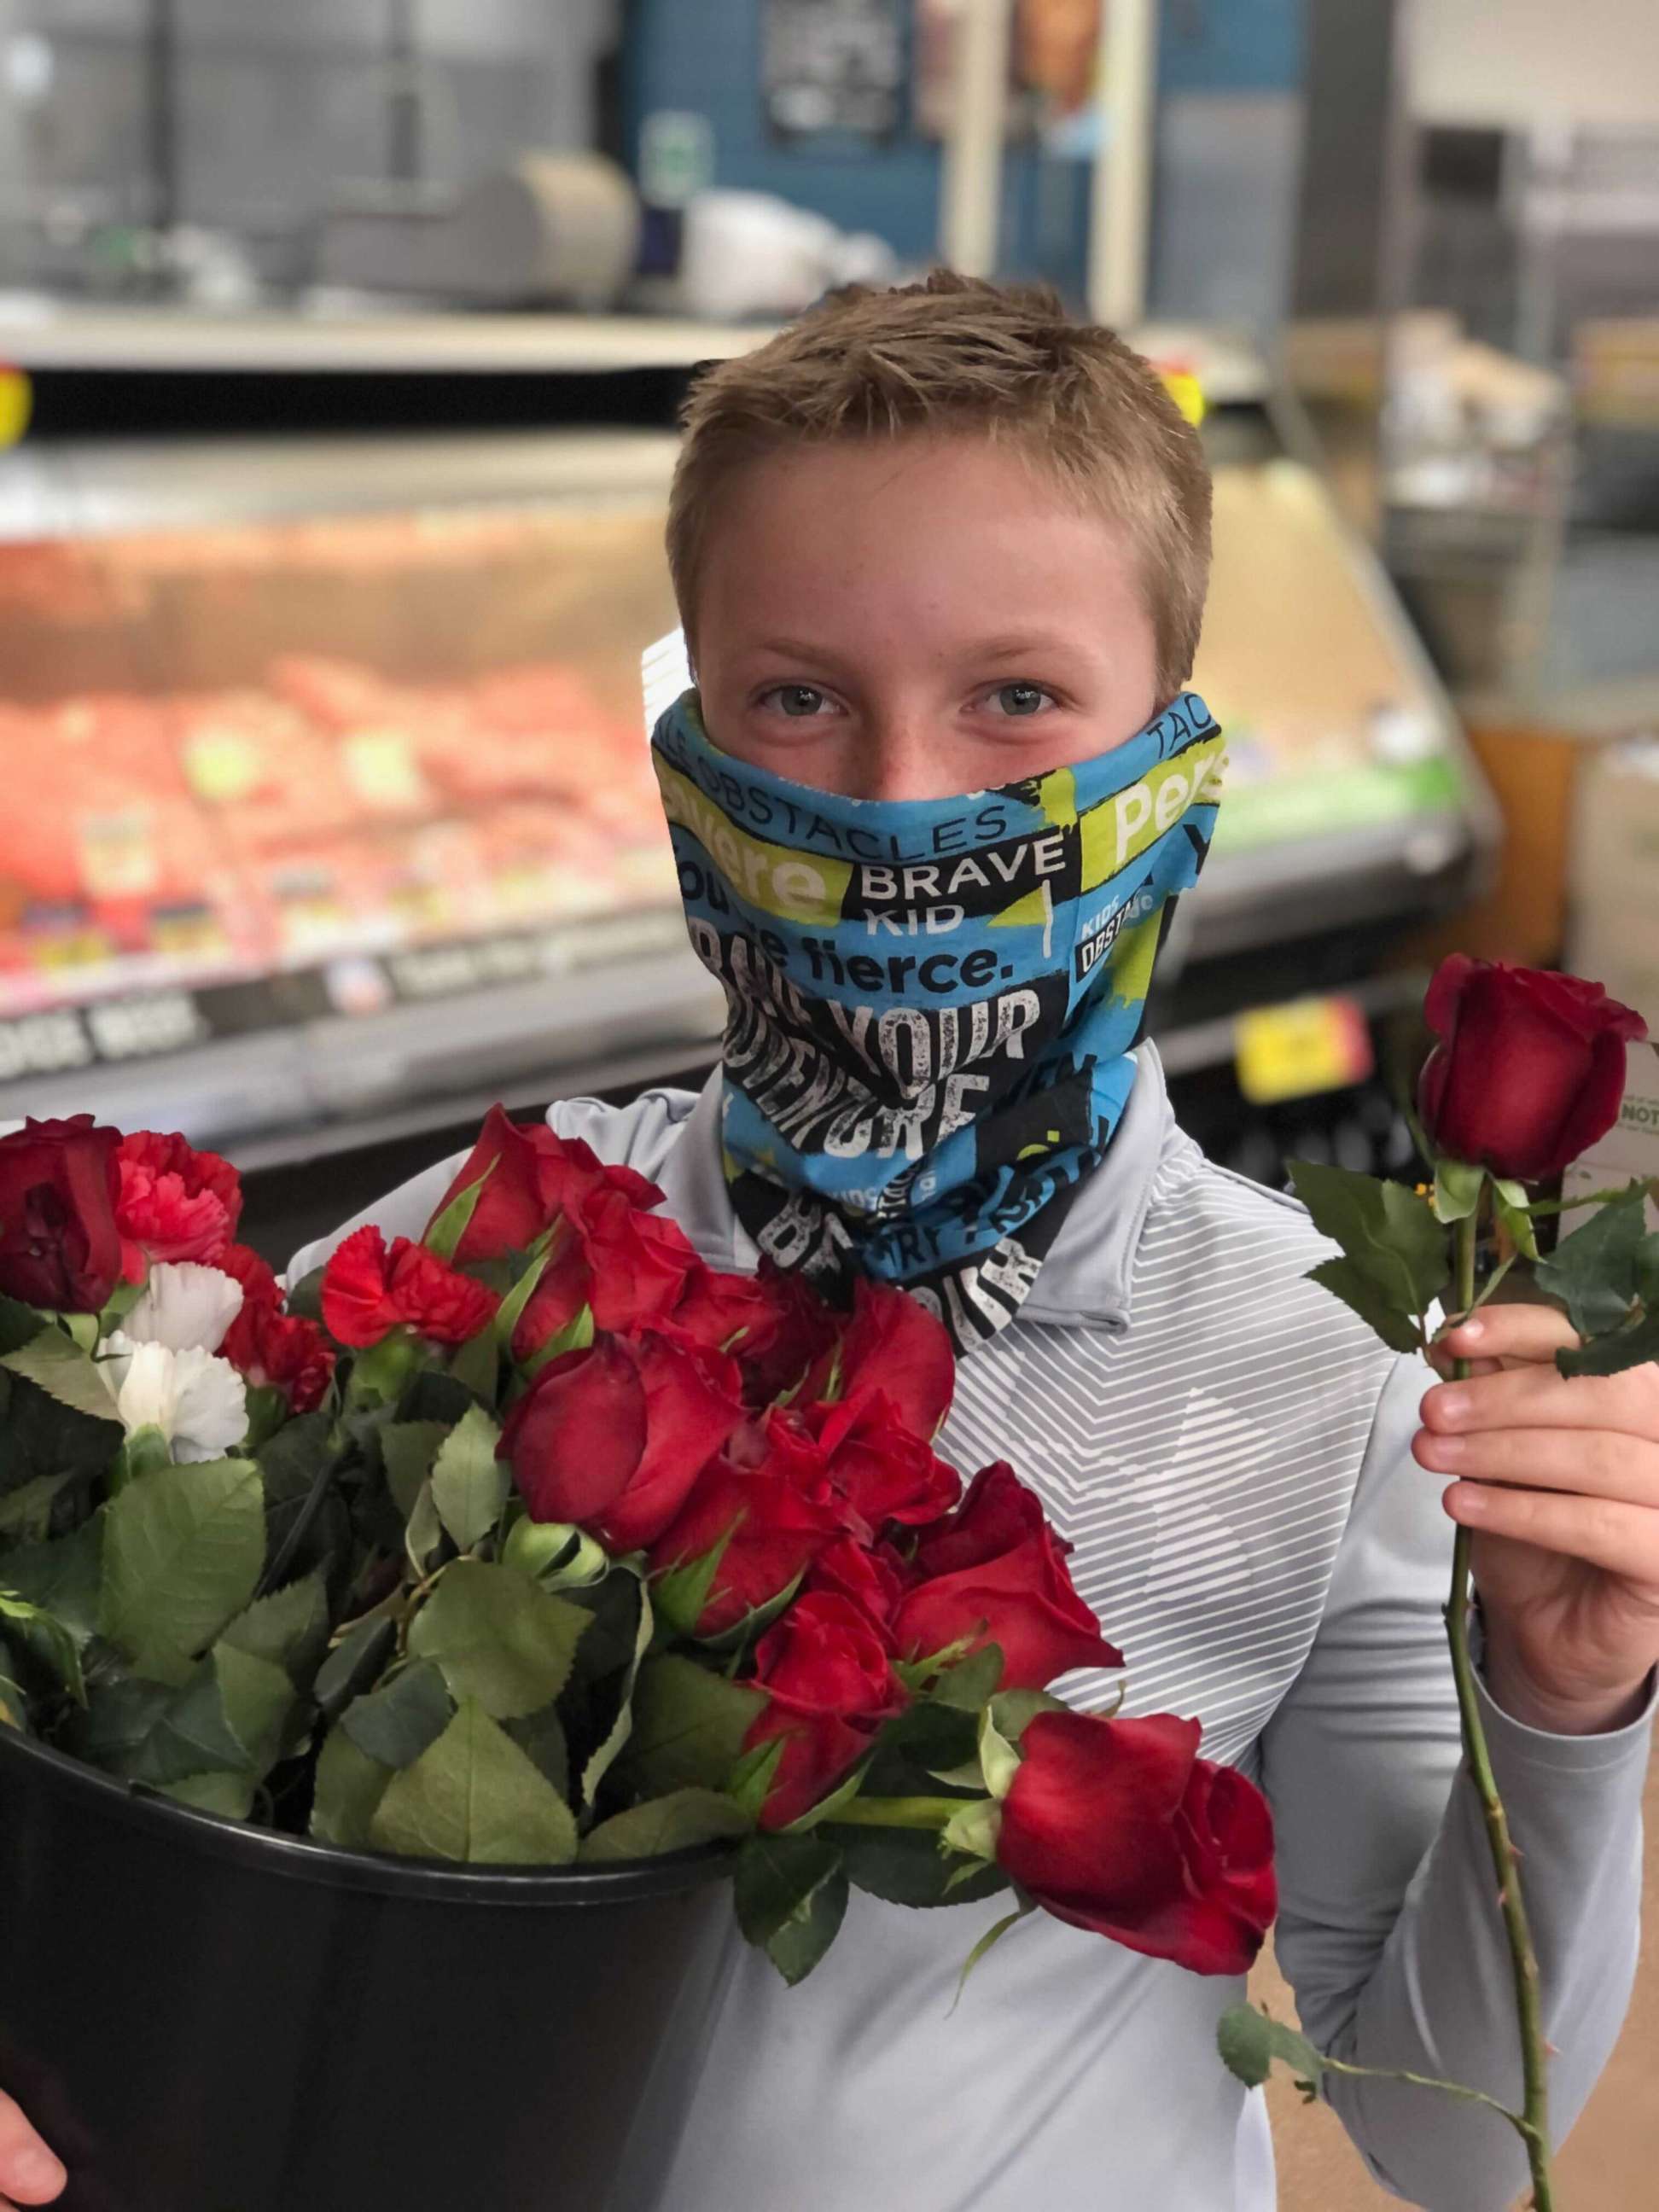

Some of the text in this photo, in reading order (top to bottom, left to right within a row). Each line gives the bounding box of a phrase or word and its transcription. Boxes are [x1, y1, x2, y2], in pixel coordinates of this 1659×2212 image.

[696, 756, 1006, 860] OBSTACLES
[860, 831, 1066, 900] BRAVE
[862, 904, 965, 936] KID
[802, 936, 1014, 995] fierce.
[824, 988, 1040, 1099] YOUR
